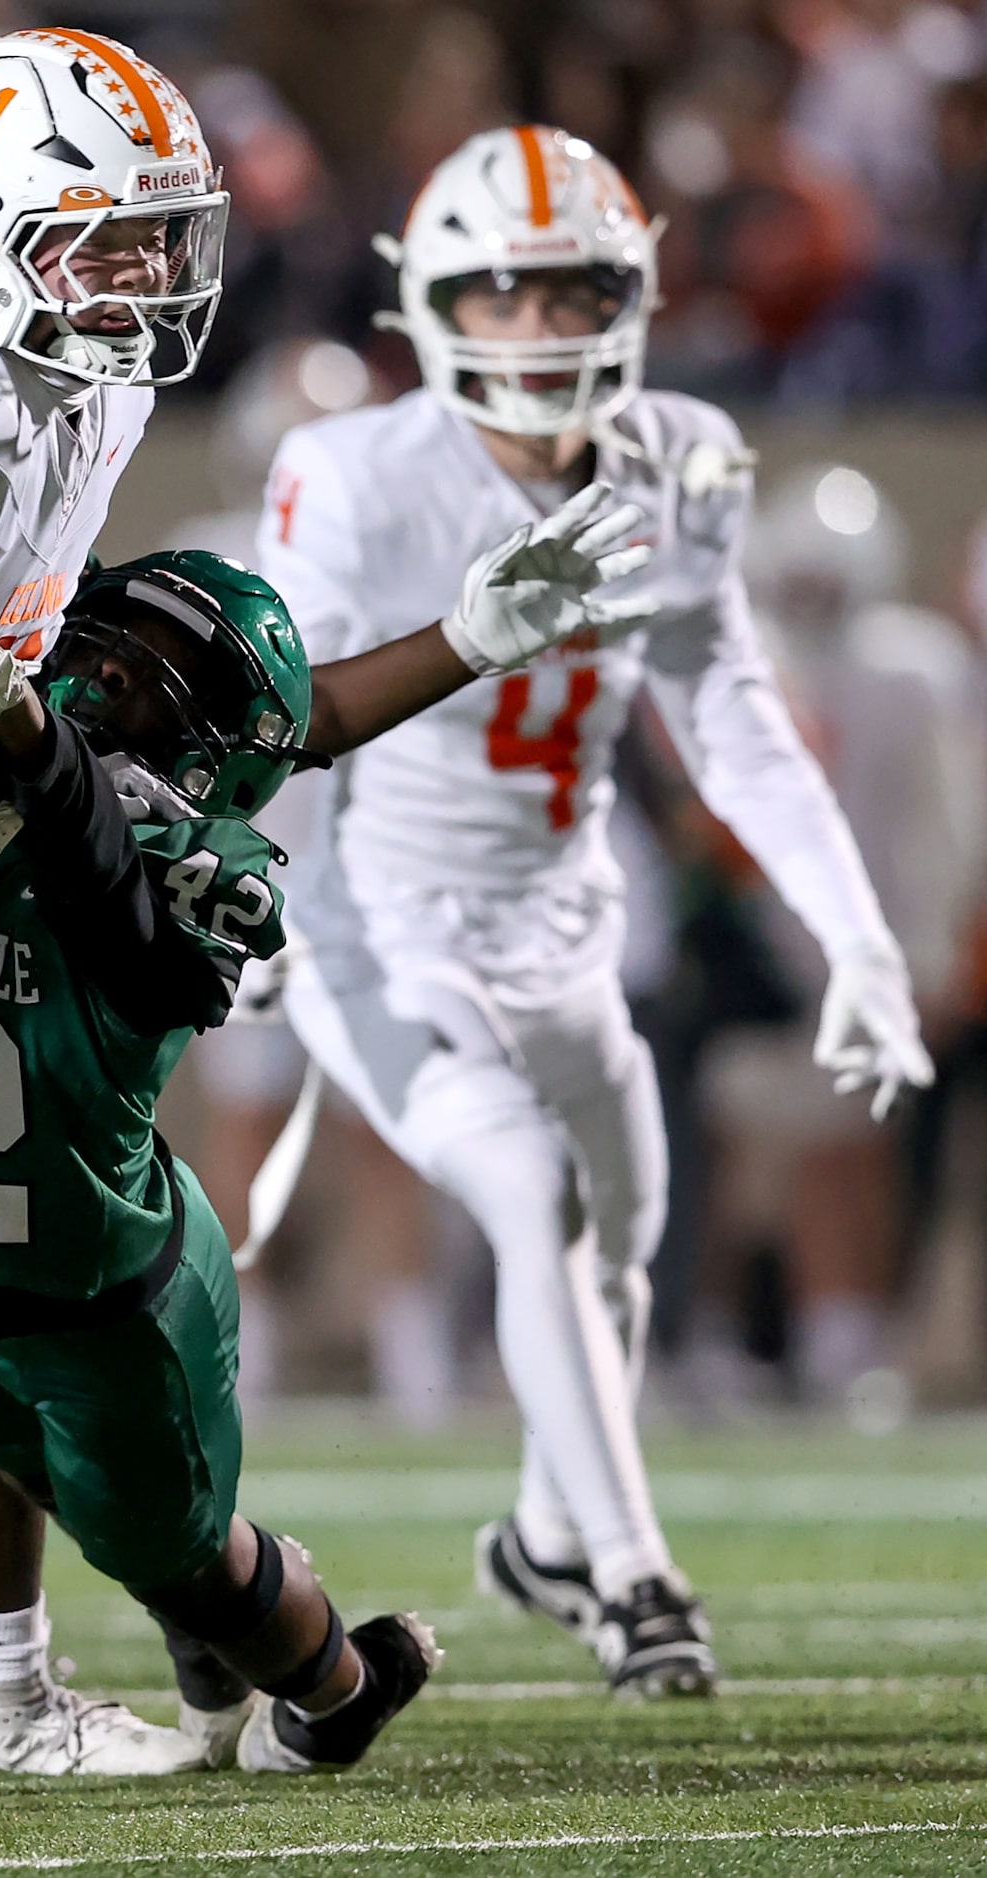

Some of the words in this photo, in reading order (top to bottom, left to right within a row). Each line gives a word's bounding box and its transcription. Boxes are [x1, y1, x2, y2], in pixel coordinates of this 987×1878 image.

[138, 168, 200, 192] Riddell
[485, 665, 599, 833] 4
[164, 849, 273, 952] 42
